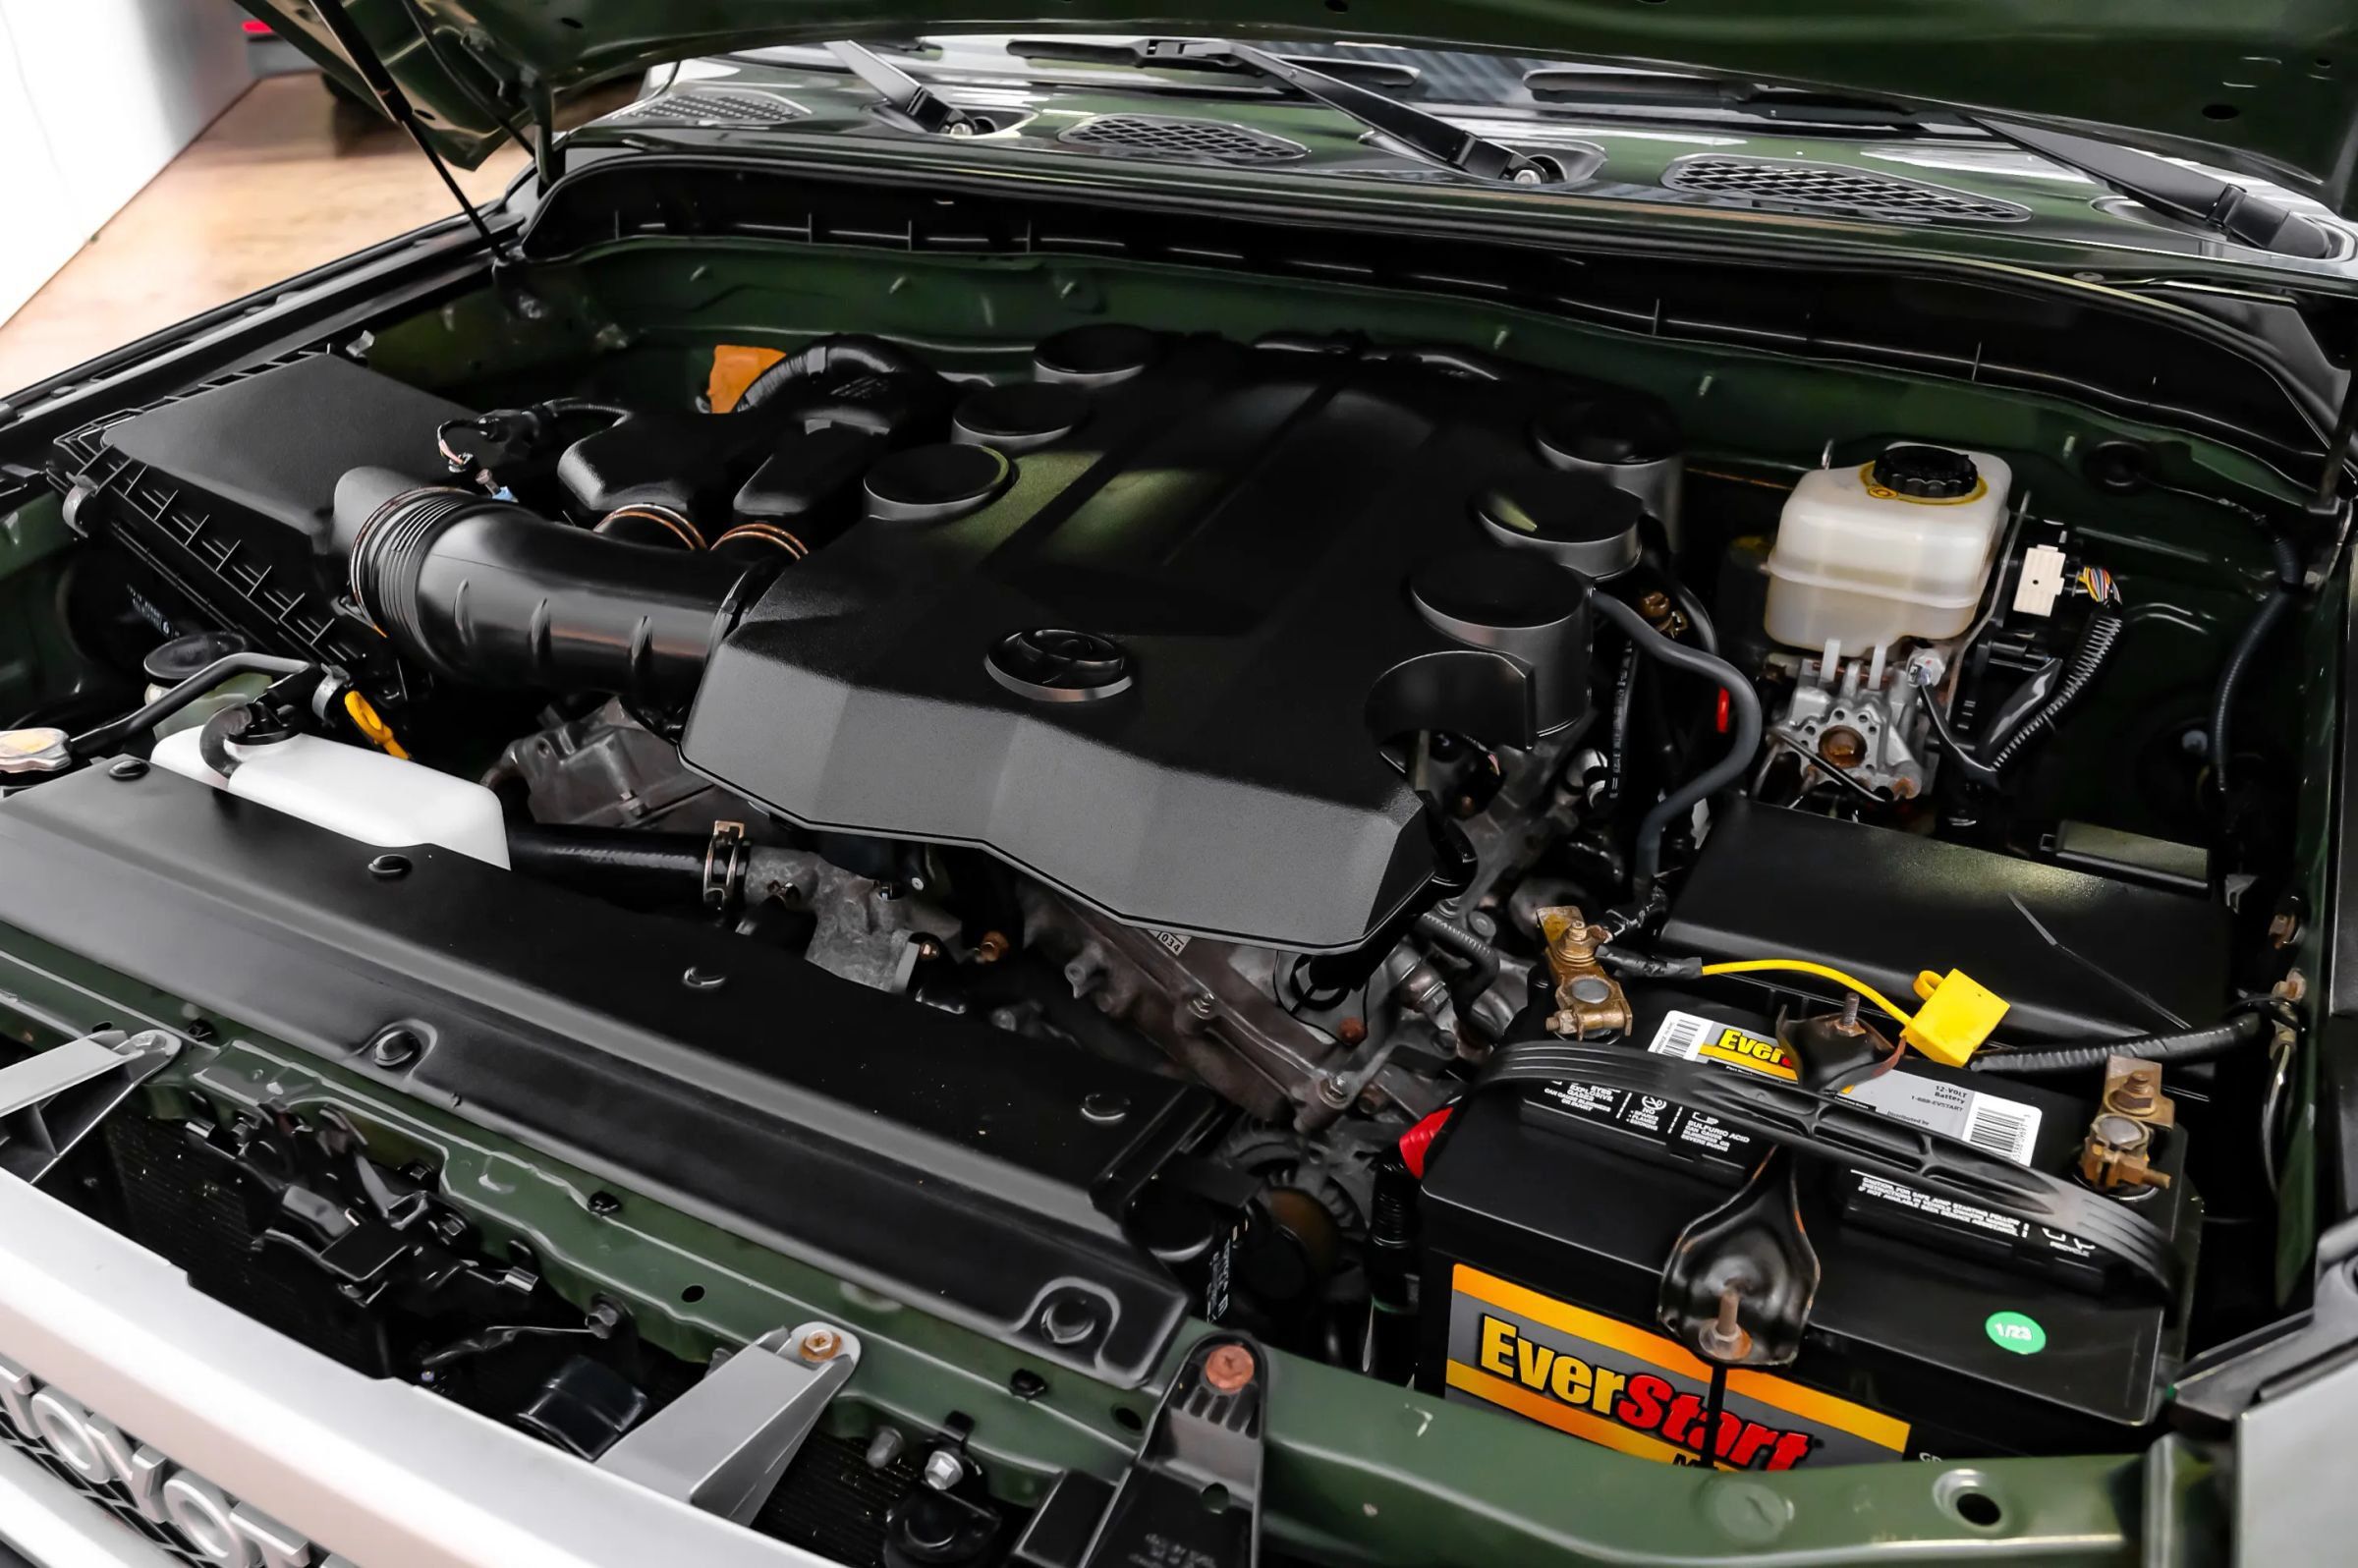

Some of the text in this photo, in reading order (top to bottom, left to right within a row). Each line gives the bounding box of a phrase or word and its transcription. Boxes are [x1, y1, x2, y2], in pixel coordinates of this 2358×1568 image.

[1718, 1028, 1793, 1068] Ever
[1936, 1086, 1968, 1098] 12-VOLT
[1728, 1133, 1750, 1143] ACID
[1478, 1314, 1814, 1471] EverStart
